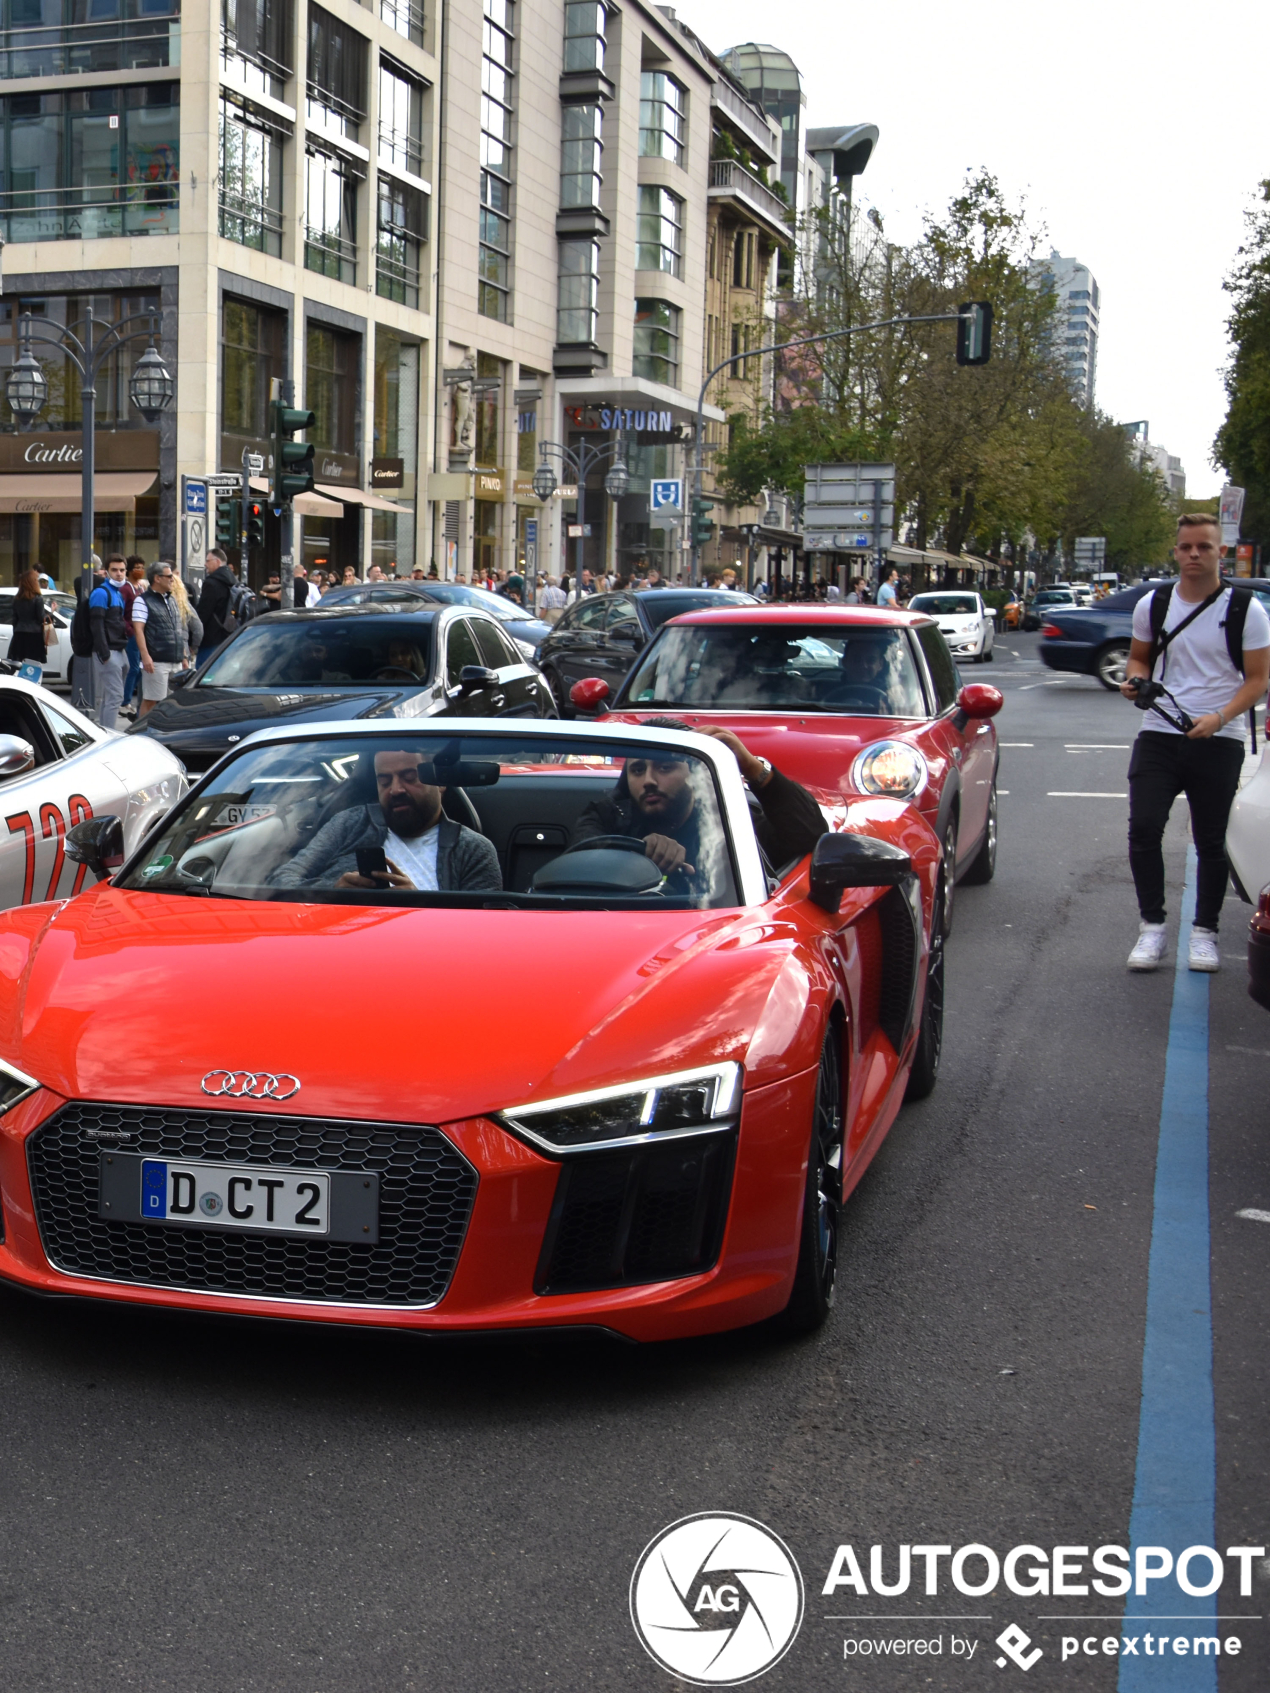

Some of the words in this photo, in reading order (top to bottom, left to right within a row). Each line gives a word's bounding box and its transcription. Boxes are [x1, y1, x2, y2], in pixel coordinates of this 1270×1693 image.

[600, 408, 672, 432] SATURN
[24, 442, 83, 463] Cartie
[321, 457, 342, 477] Cartier
[373, 469, 400, 478] Cartier
[480, 476, 502, 491] PINKO
[15, 500, 53, 512] Cartier
[150, 1195, 159, 1207] D
[170, 1171, 196, 1214] D
[227, 1175, 284, 1222] CT
[294, 1182, 321, 1226] 2
